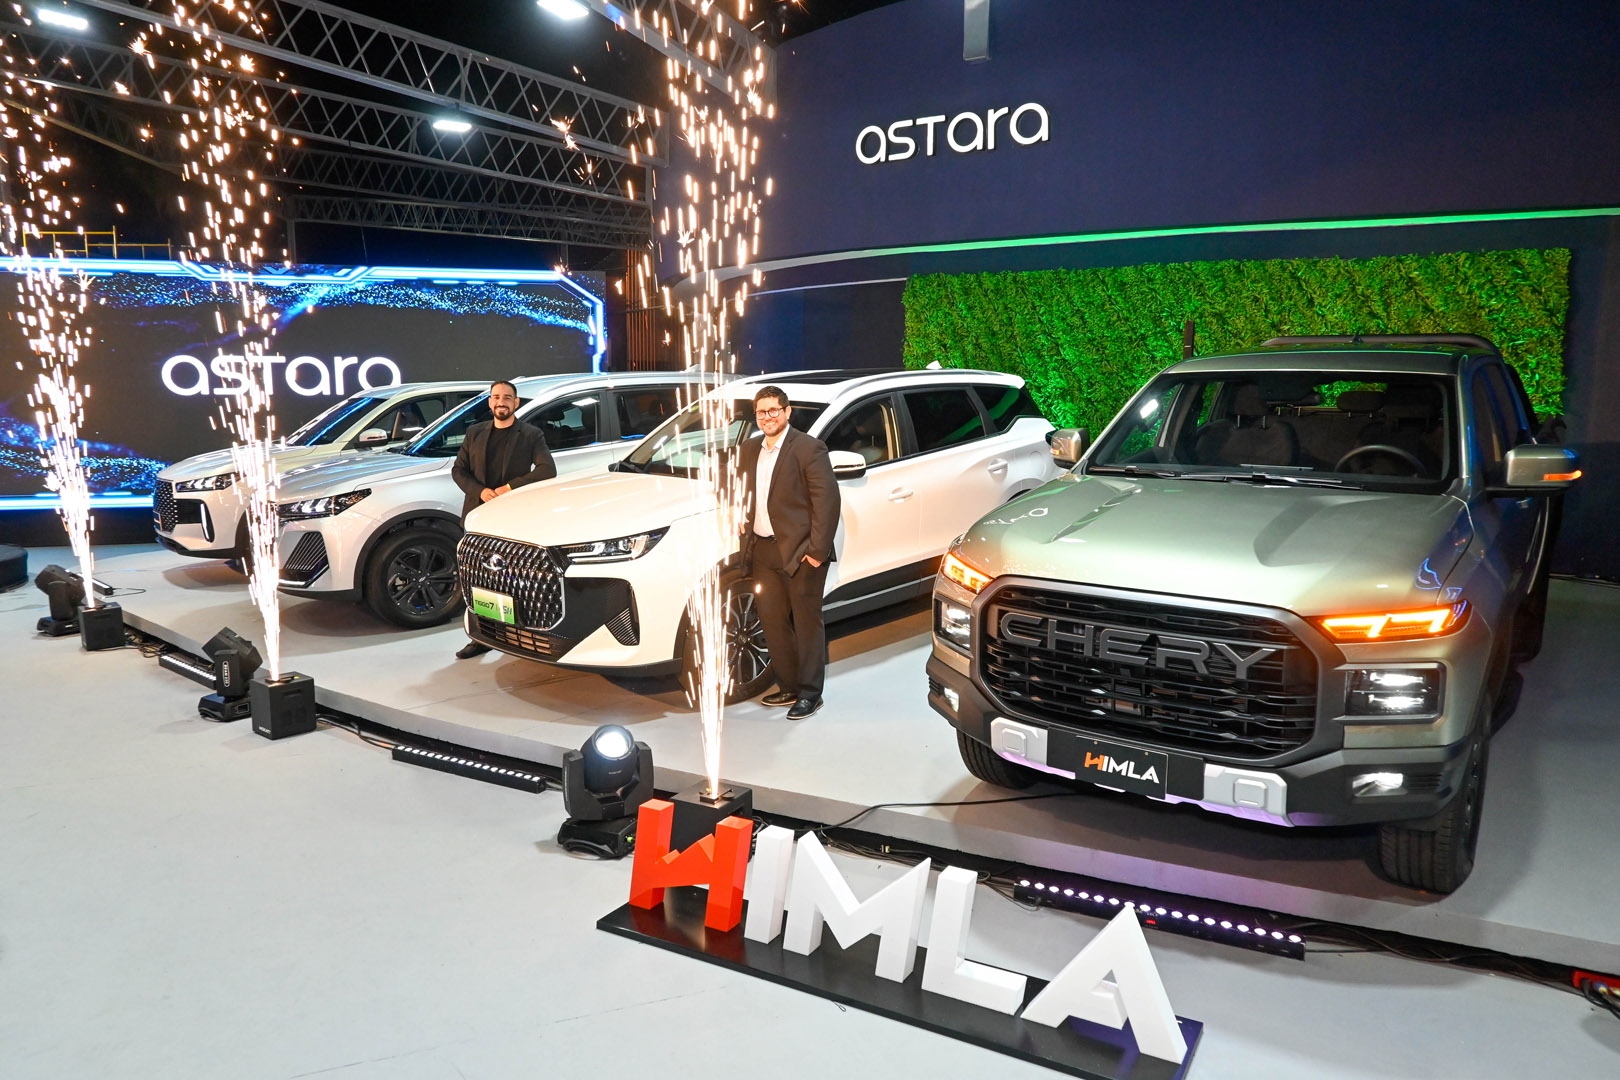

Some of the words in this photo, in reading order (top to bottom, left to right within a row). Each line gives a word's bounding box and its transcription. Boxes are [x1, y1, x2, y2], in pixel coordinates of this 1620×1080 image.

[856, 102, 1049, 164] astara
[161, 354, 402, 397] astara
[1000, 612, 1277, 680] CHERY
[1084, 752, 1160, 784] HIMLA
[628, 799, 1189, 1064] HIMLA
